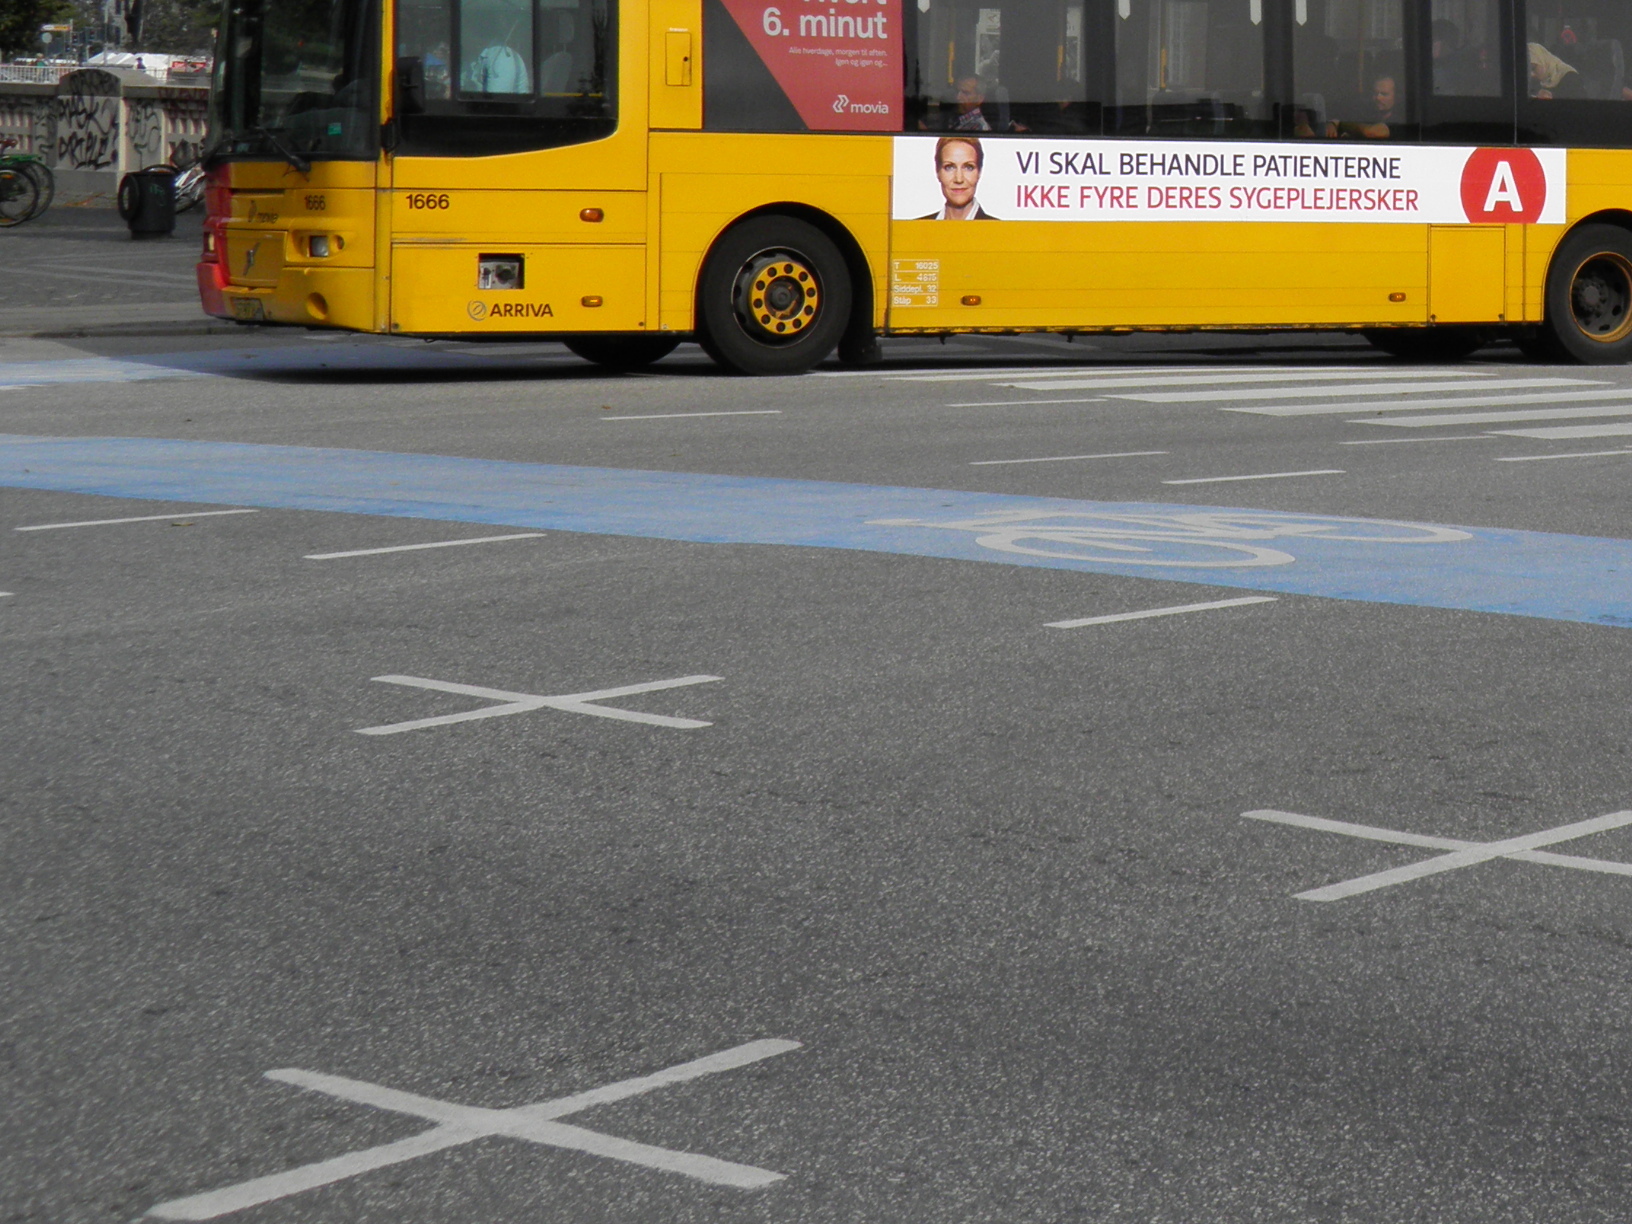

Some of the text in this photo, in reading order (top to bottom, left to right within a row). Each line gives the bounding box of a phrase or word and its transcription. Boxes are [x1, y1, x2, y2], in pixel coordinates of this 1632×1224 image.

[762, 7, 888, 39] 6. minut
[789, 47, 802, 55] Alle
[836, 49, 860, 57] morgen
[851, 101, 889, 114] movia
[1016, 151, 1401, 179] VI SKAL BEHANDLE PATIENTERNE
[1483, 161, 1524, 212] A
[304, 194, 326, 211] 1666
[406, 193, 450, 210] 1666
[1016, 185, 1419, 211] IKKE FYRE DERES SYGEPLEJERSKER
[490, 303, 554, 317] ARRIVA
